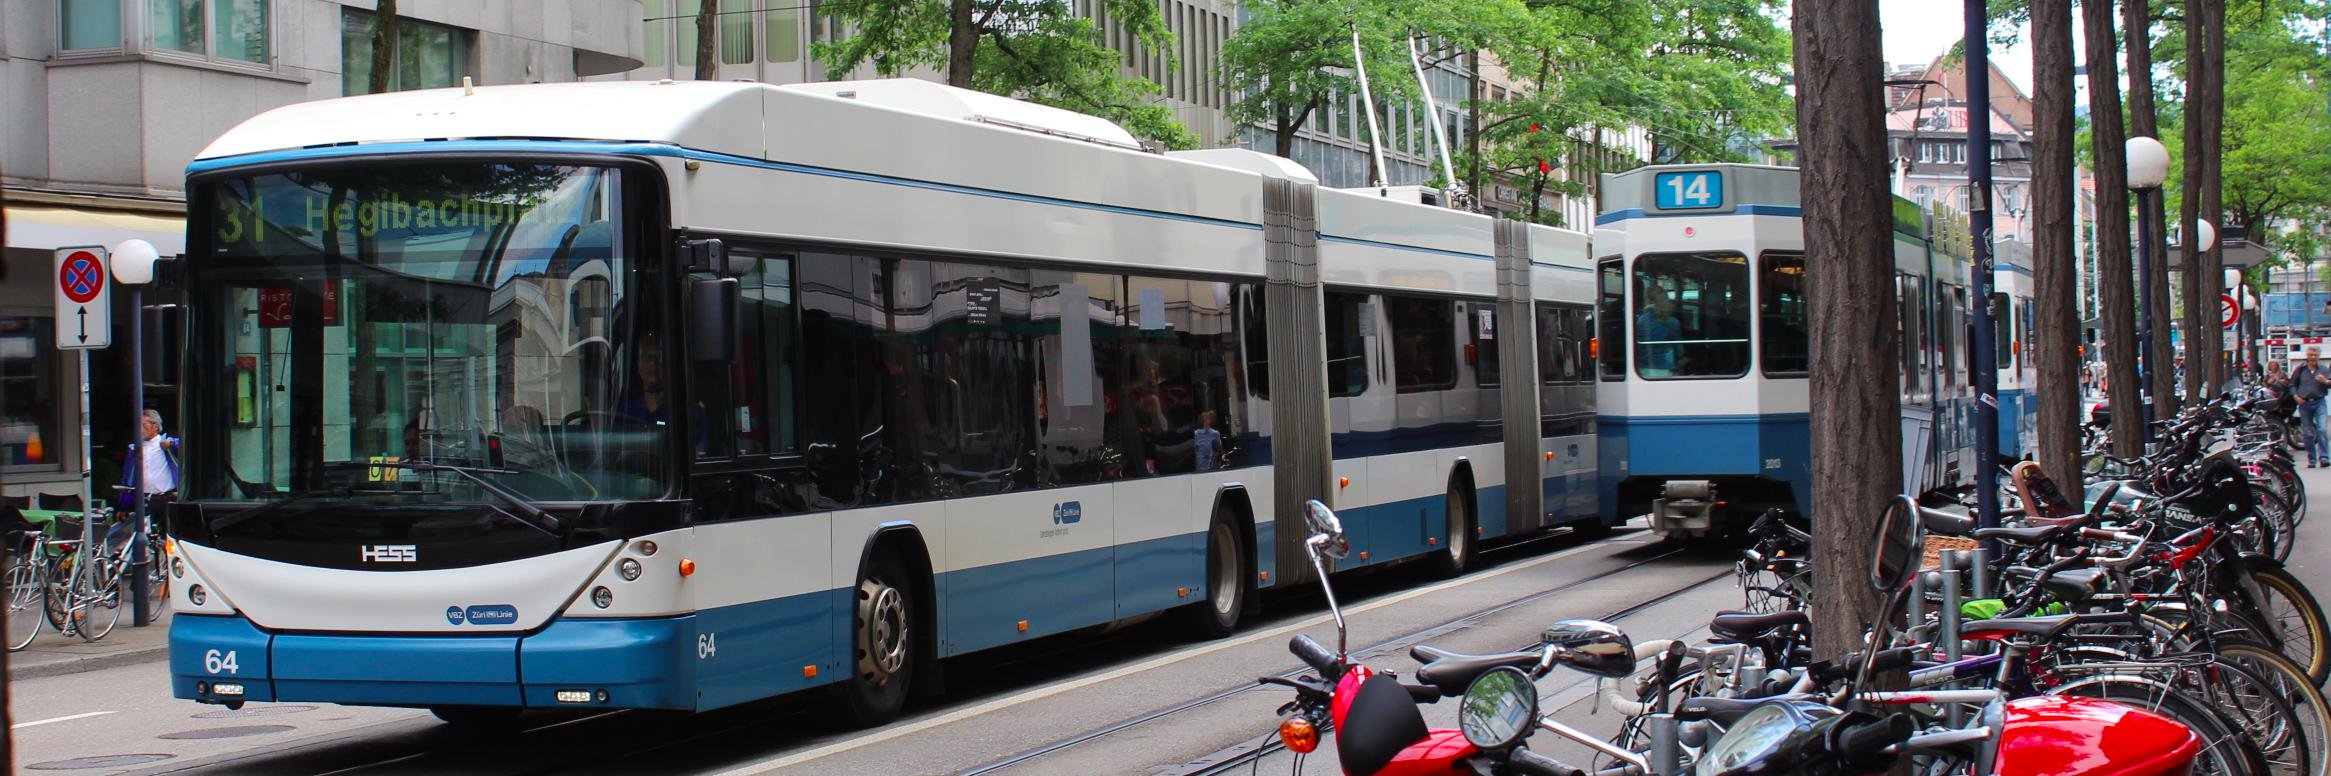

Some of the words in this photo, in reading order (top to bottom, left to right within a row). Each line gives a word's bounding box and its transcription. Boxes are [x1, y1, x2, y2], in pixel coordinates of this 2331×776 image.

[1667, 174, 1711, 205] 14
[218, 196, 264, 243] 31
[362, 544, 417, 562] HESS
[448, 611, 463, 620] VBZ
[698, 632, 716, 659] 64
[205, 648, 239, 674] 64
